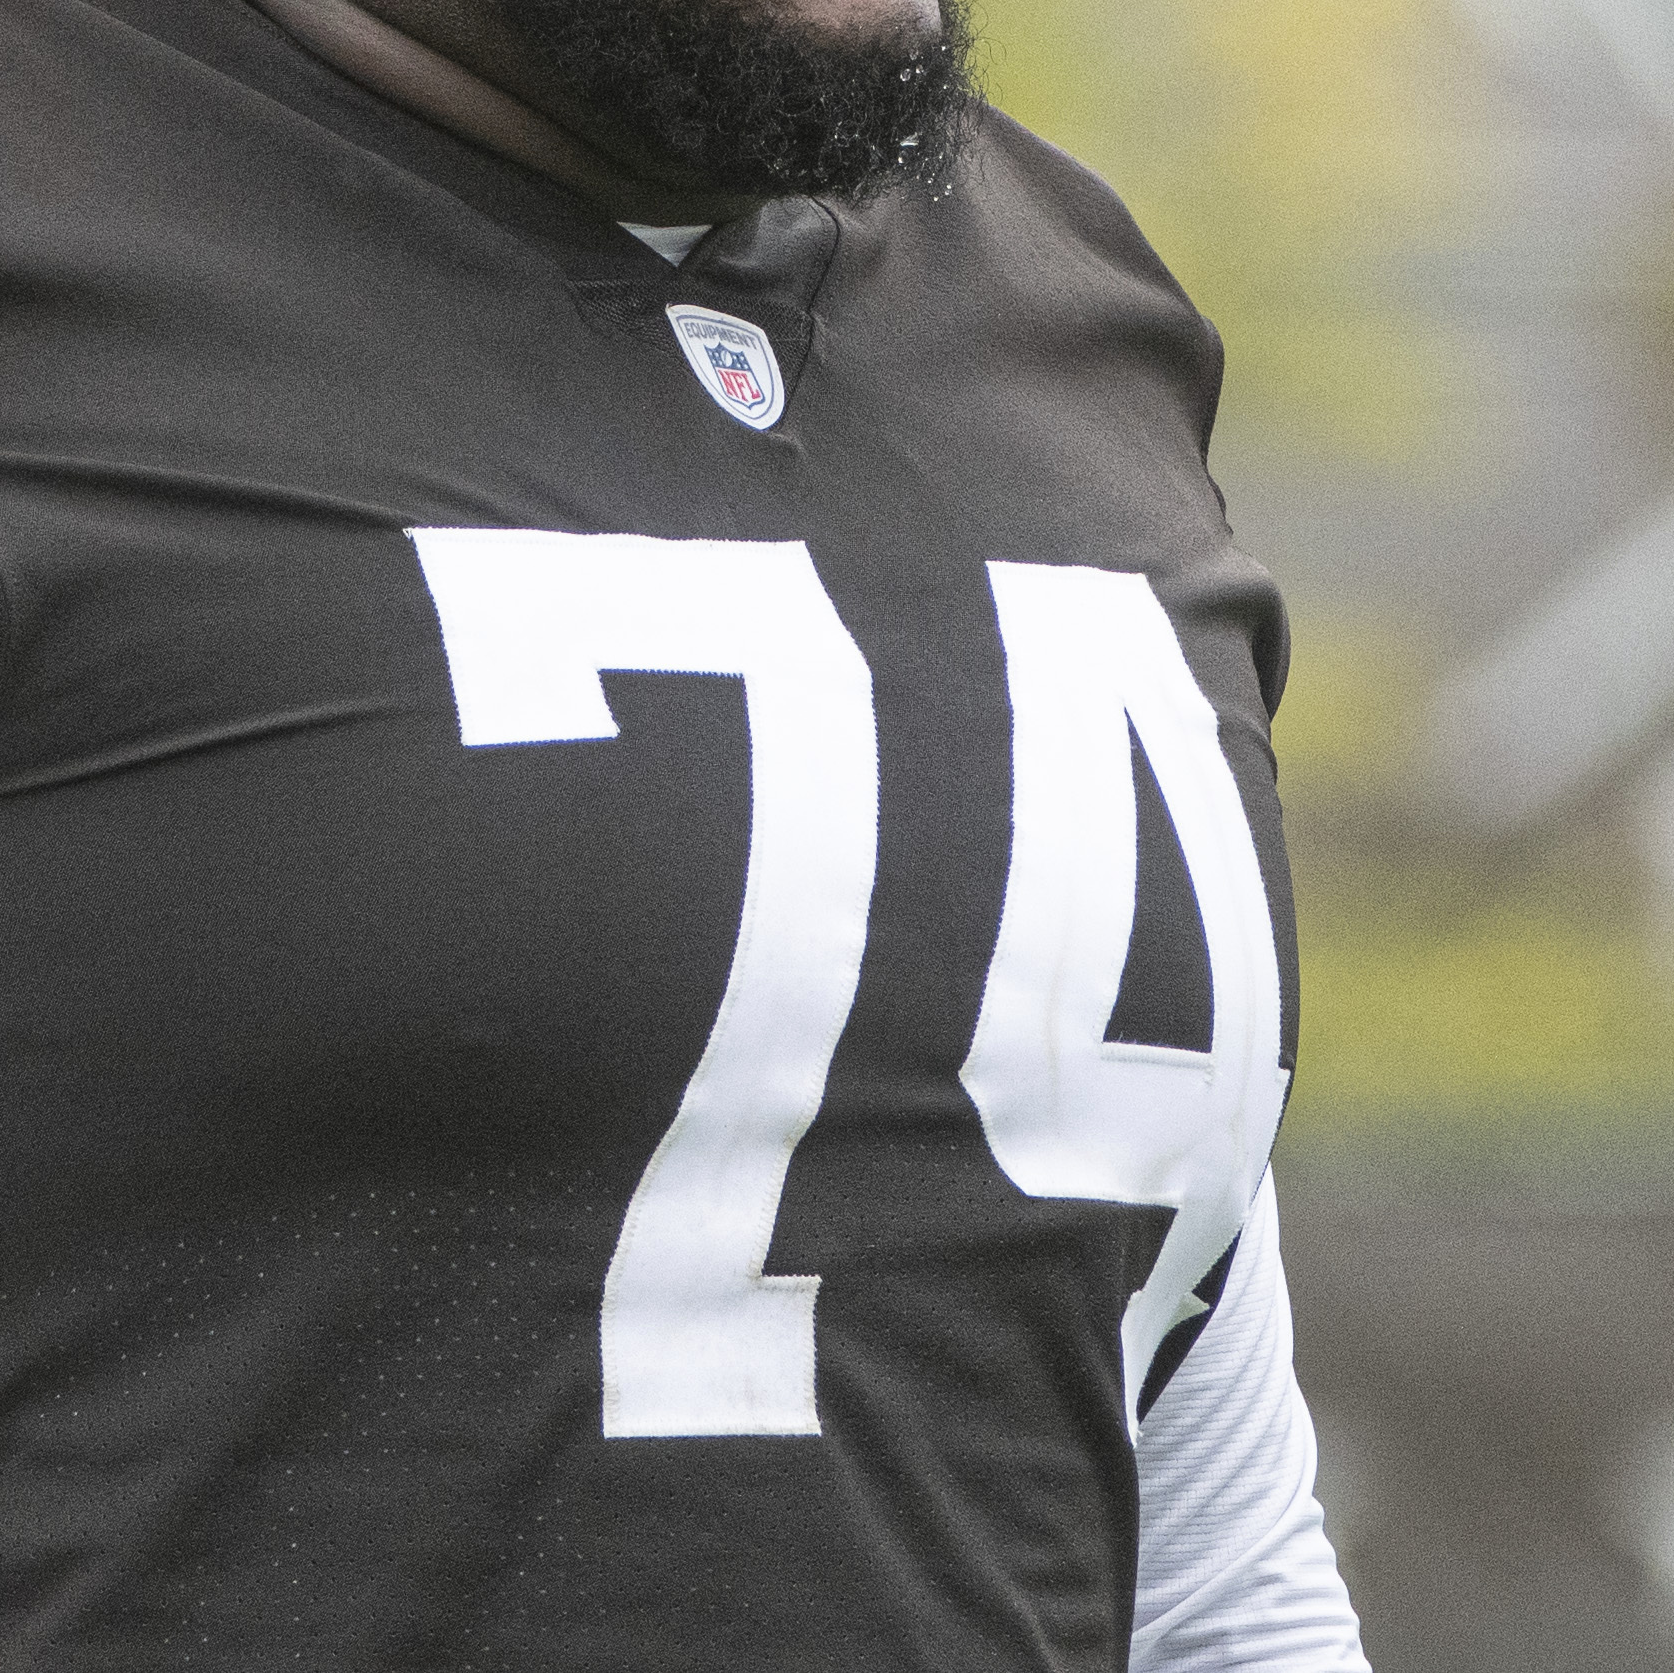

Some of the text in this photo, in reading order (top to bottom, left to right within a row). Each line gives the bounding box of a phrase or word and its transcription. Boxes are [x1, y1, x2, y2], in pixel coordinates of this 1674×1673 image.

[684, 321, 758, 350] EQUIPMENT
[717, 369, 762, 403] NFL
[405, 526, 1291, 1447] 74
